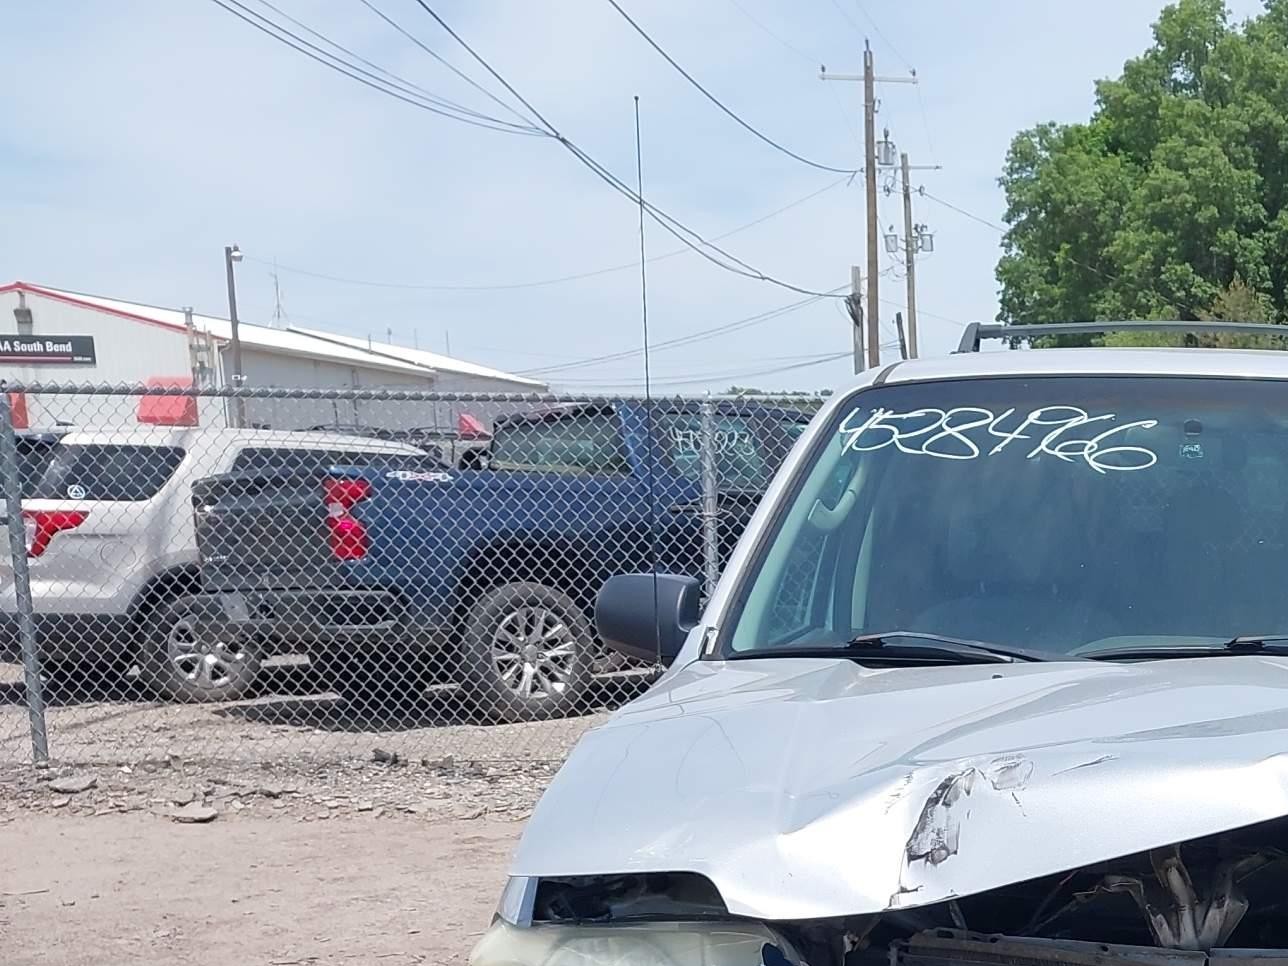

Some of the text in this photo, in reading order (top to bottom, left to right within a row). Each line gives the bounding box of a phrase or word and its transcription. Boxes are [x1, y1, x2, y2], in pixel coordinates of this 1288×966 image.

[13, 341, 44, 353] South
[45, 341, 72, 353] Bend
[839, 406, 1158, 474] 45284966
